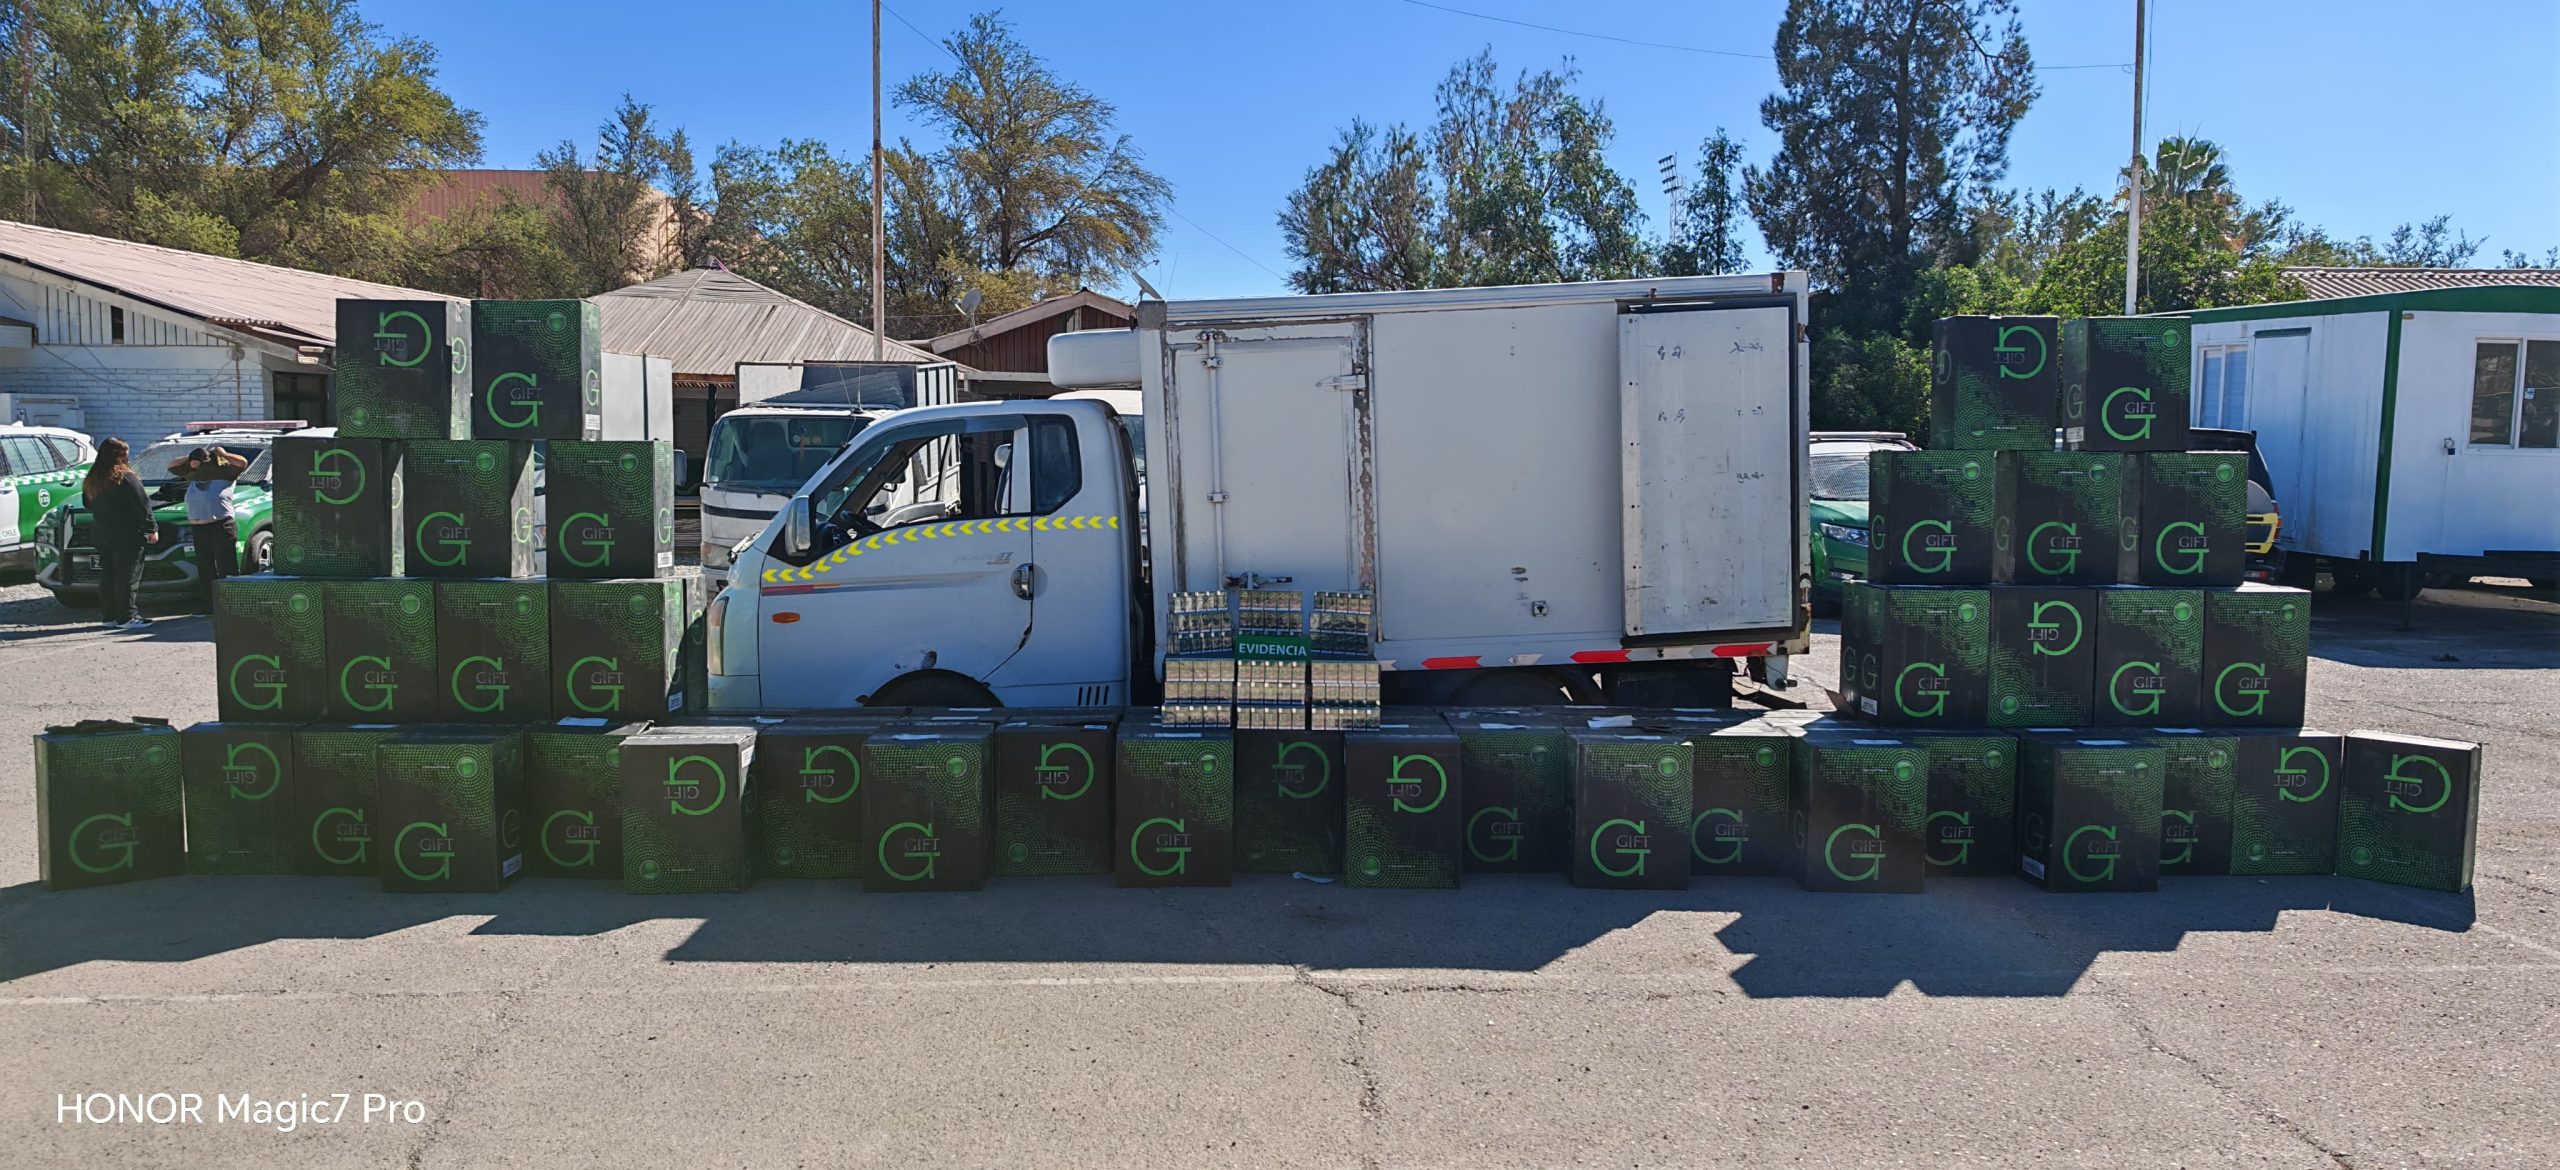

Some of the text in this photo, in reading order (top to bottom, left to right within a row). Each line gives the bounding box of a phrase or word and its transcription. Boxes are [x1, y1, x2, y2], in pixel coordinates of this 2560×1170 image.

[373, 311, 432, 367] G
[374, 339, 407, 352] GIFT
[1994, 325, 2047, 379] G
[1994, 353, 2025, 365] GIFT
[487, 372, 543, 428] G
[511, 387, 543, 400] GIFT
[2102, 387, 2156, 441] G
[2125, 402, 2156, 414] GIFT
[309, 449, 365, 505] G
[309, 476, 341, 489] GIFT
[416, 511, 472, 567] G
[439, 526, 472, 540] GIFT
[559, 512, 615, 567] G
[582, 527, 614, 540] GIFT
[1926, 534, 1957, 547] GIFT
[1902, 520, 1958, 573] G
[2027, 521, 2081, 575] G
[2050, 536, 2081, 549] GIFT
[2156, 521, 2209, 575] G
[2179, 536, 2209, 548] GIFT
[2027, 600, 2082, 656] G
[2028, 628, 2059, 641] GIFT
[1239, 643, 1307, 656] EVIDENCIA
[230, 654, 287, 711] G
[253, 669, 287, 682] GIFT
[364, 671, 397, 683] GIFT
[476, 672, 509, 685] GIFT
[591, 672, 624, 685] GIFT
[2134, 677, 2166, 689] GIFT
[341, 655, 398, 712] G
[452, 656, 509, 712] G
[567, 657, 624, 712] G
[1895, 662, 1950, 717] G
[1919, 677, 1950, 690] GIFT
[2110, 661, 2165, 716] G
[2215, 662, 2270, 716] G
[2239, 677, 2271, 690] GIFT
[222, 742, 281, 800] G
[224, 771, 256, 784] GIFT
[799, 745, 860, 803] G
[1035, 743, 1094, 800] G
[1272, 742, 1329, 798] G
[1272, 770, 1304, 783] GIFT
[2274, 747, 2329, 802] G
[663, 756, 725, 816] G
[800, 775, 834, 788] GIFT
[1036, 772, 1069, 785] GIFT
[1387, 754, 1447, 813] G
[2274, 774, 2306, 788] GIFT
[2384, 754, 2451, 813] G
[664, 786, 699, 799] GIFT
[1387, 784, 1422, 798] GIFT
[2384, 782, 2422, 797] GIFT
[99, 827, 138, 842] GIFT
[313, 808, 371, 864] G
[337, 823, 370, 836] GIFT
[566, 826, 600, 839] GIFT
[1467, 806, 1524, 862] G
[1491, 822, 1524, 835] GIFT
[1691, 808, 1749, 863] G
[1715, 823, 1749, 837] GIFT
[1942, 826, 1974, 839] GIFT
[2167, 825, 2199, 838] GIFT
[69, 812, 138, 873] G
[419, 838, 453, 852] GIFT
[541, 809, 600, 867] G
[905, 838, 939, 851] GIFT
[1157, 833, 1192, 846] GIFT
[1617, 834, 1651, 848] GIFT
[1926, 811, 1974, 866] G
[394, 822, 455, 881] G
[879, 822, 940, 881] G
[1131, 818, 1191, 876] G
[1591, 819, 1651, 877] G
[1825, 823, 1886, 881] G
[1852, 840, 1886, 853] GIFT
[2063, 825, 2121, 882] G
[2088, 840, 2122, 854] GIFT
